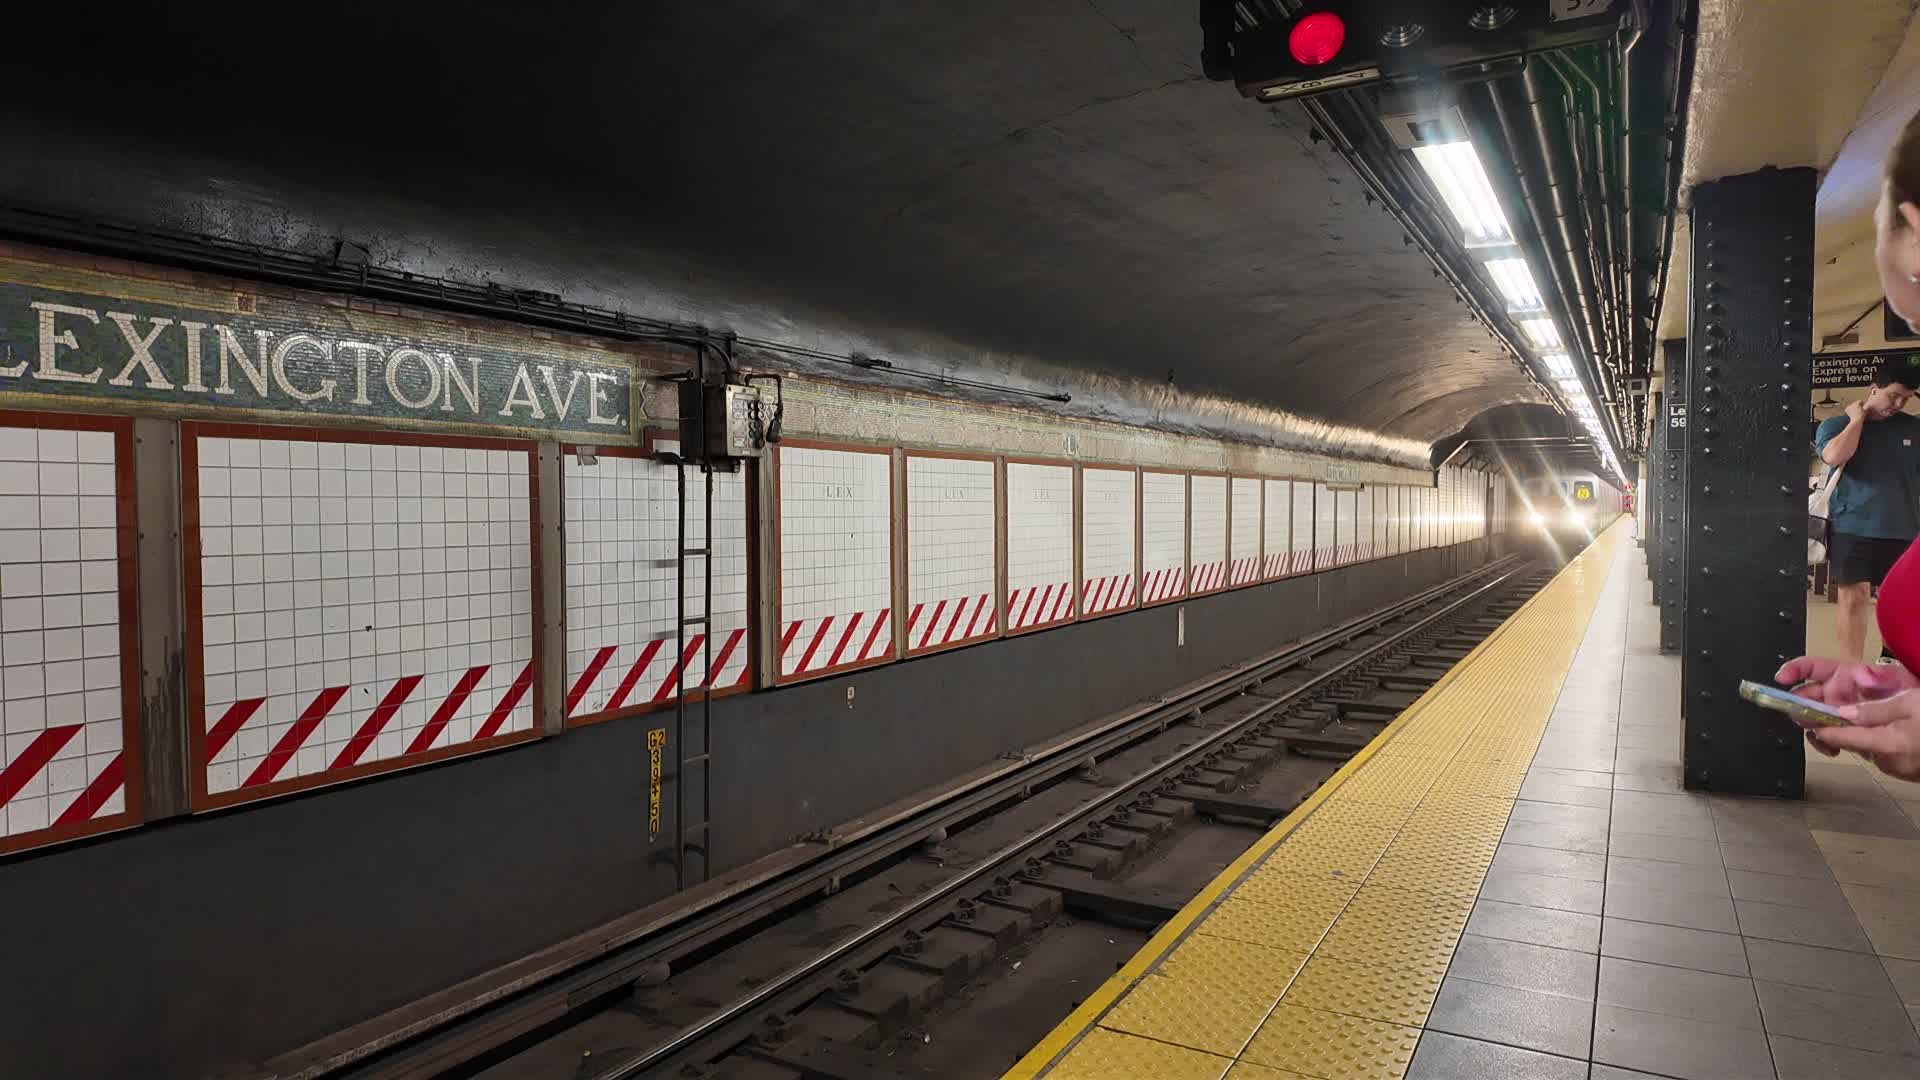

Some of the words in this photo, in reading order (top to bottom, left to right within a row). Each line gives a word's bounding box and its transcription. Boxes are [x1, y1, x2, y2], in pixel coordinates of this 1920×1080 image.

[1812, 358, 1868, 367] Lexington
[1872, 355, 1885, 364] Av
[1812, 367, 1858, 376] Express
[1812, 375, 1842, 384] lower
[1847, 373, 1873, 382] level
[1670, 417, 1687, 428] 59
[826, 485, 853, 498] LEX
